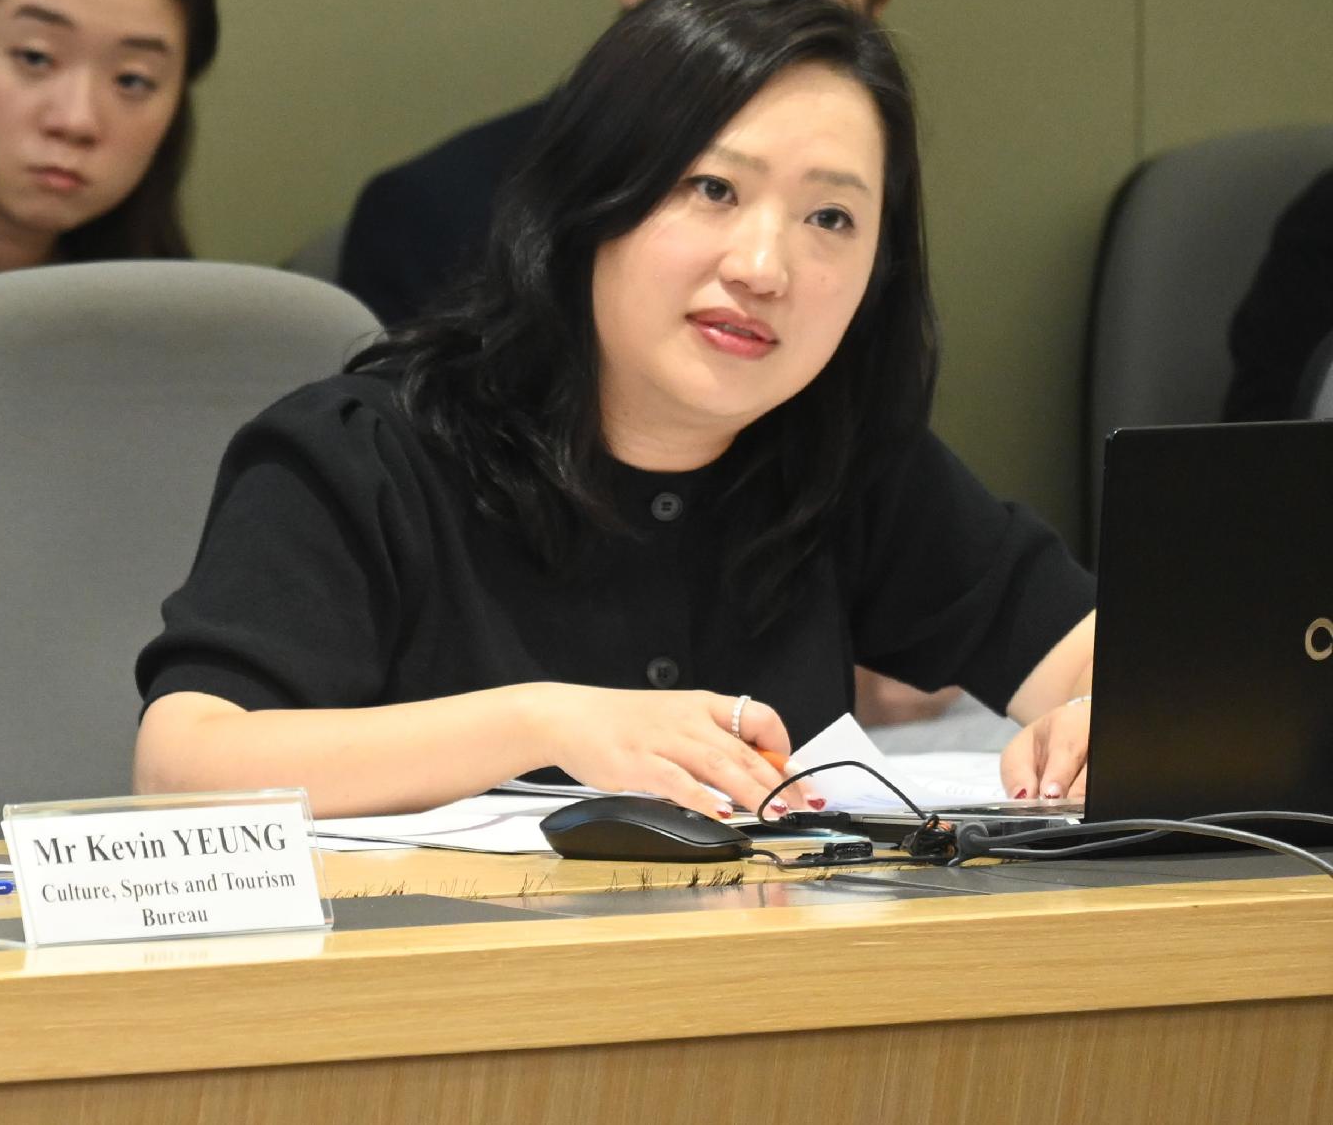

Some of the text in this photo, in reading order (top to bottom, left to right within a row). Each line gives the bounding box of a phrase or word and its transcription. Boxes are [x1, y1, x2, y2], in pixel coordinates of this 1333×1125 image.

[33, 823, 286, 865] Mr Kevin YEUNG
[42, 870, 296, 904] Culture, Sports and Tourism
[141, 908, 209, 928] Bureau
